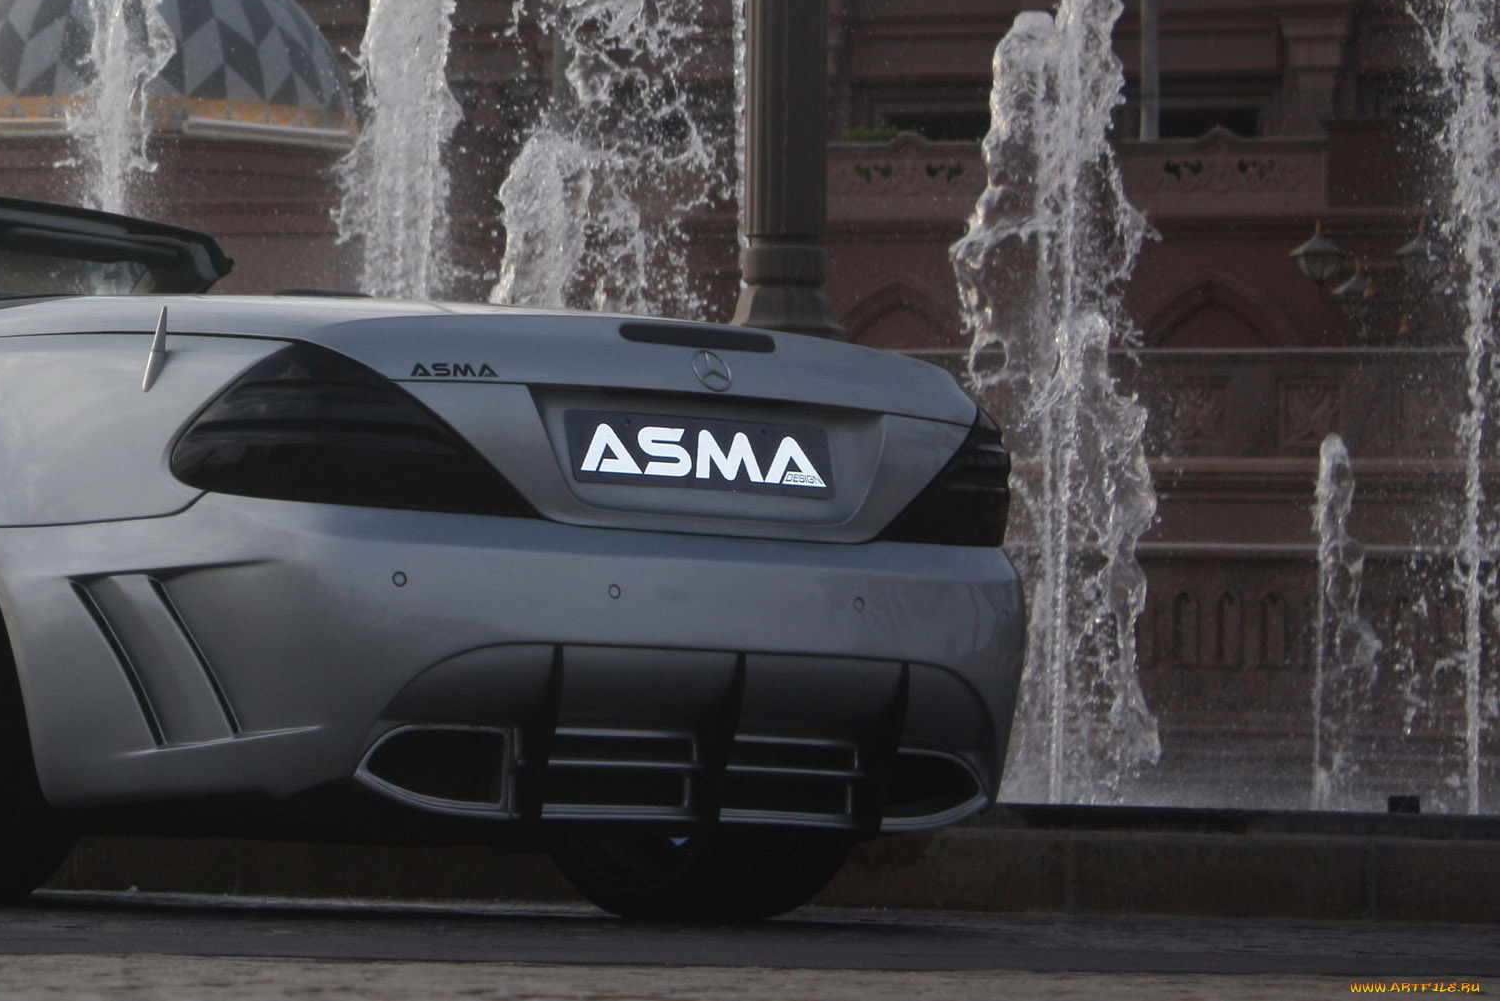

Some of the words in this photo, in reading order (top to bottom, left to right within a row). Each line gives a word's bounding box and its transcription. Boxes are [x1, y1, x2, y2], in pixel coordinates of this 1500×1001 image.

[411, 363, 498, 377] ASMA
[581, 423, 827, 487] ASMA
[786, 473, 823, 484] DESIGN
